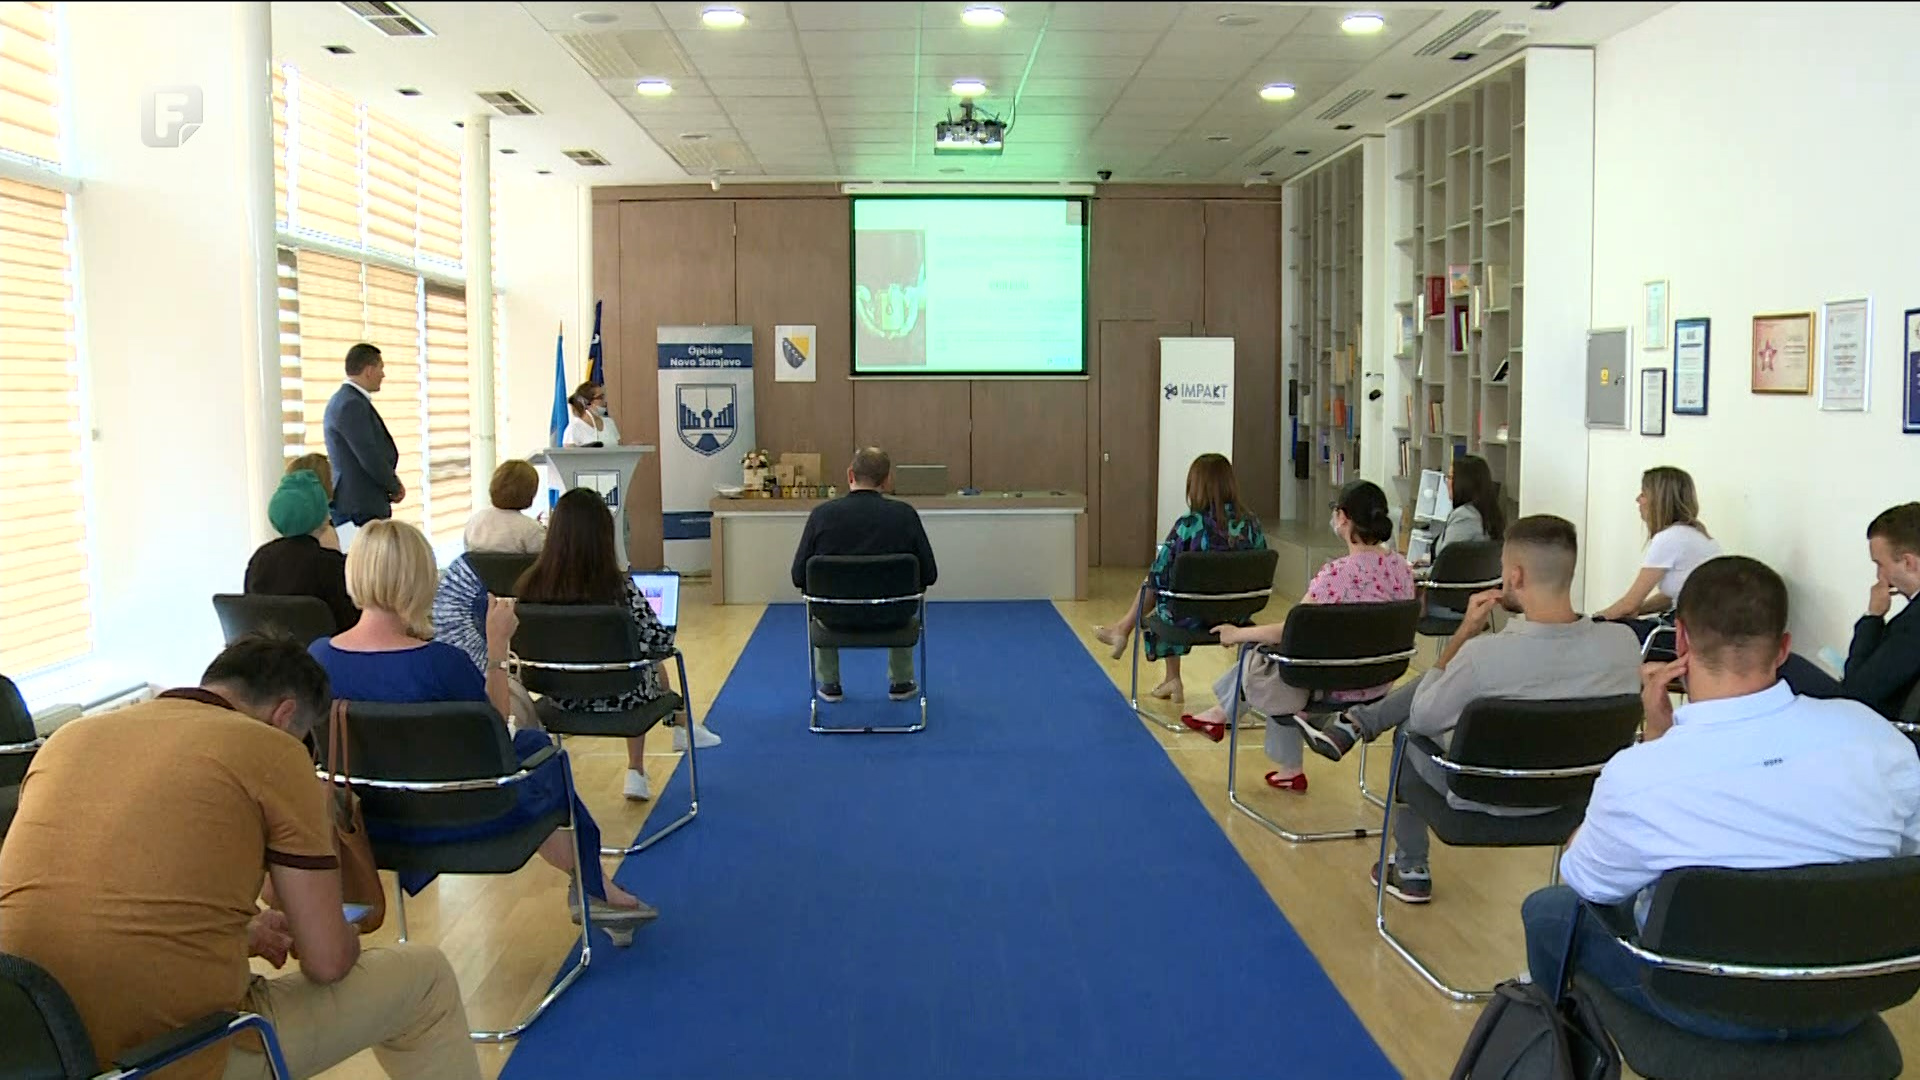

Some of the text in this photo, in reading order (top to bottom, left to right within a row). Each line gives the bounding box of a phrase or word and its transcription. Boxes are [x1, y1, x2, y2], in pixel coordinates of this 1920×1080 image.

[670, 357, 742, 368] Novo Sarajevo
[1181, 383, 1229, 398] IMPAKT
